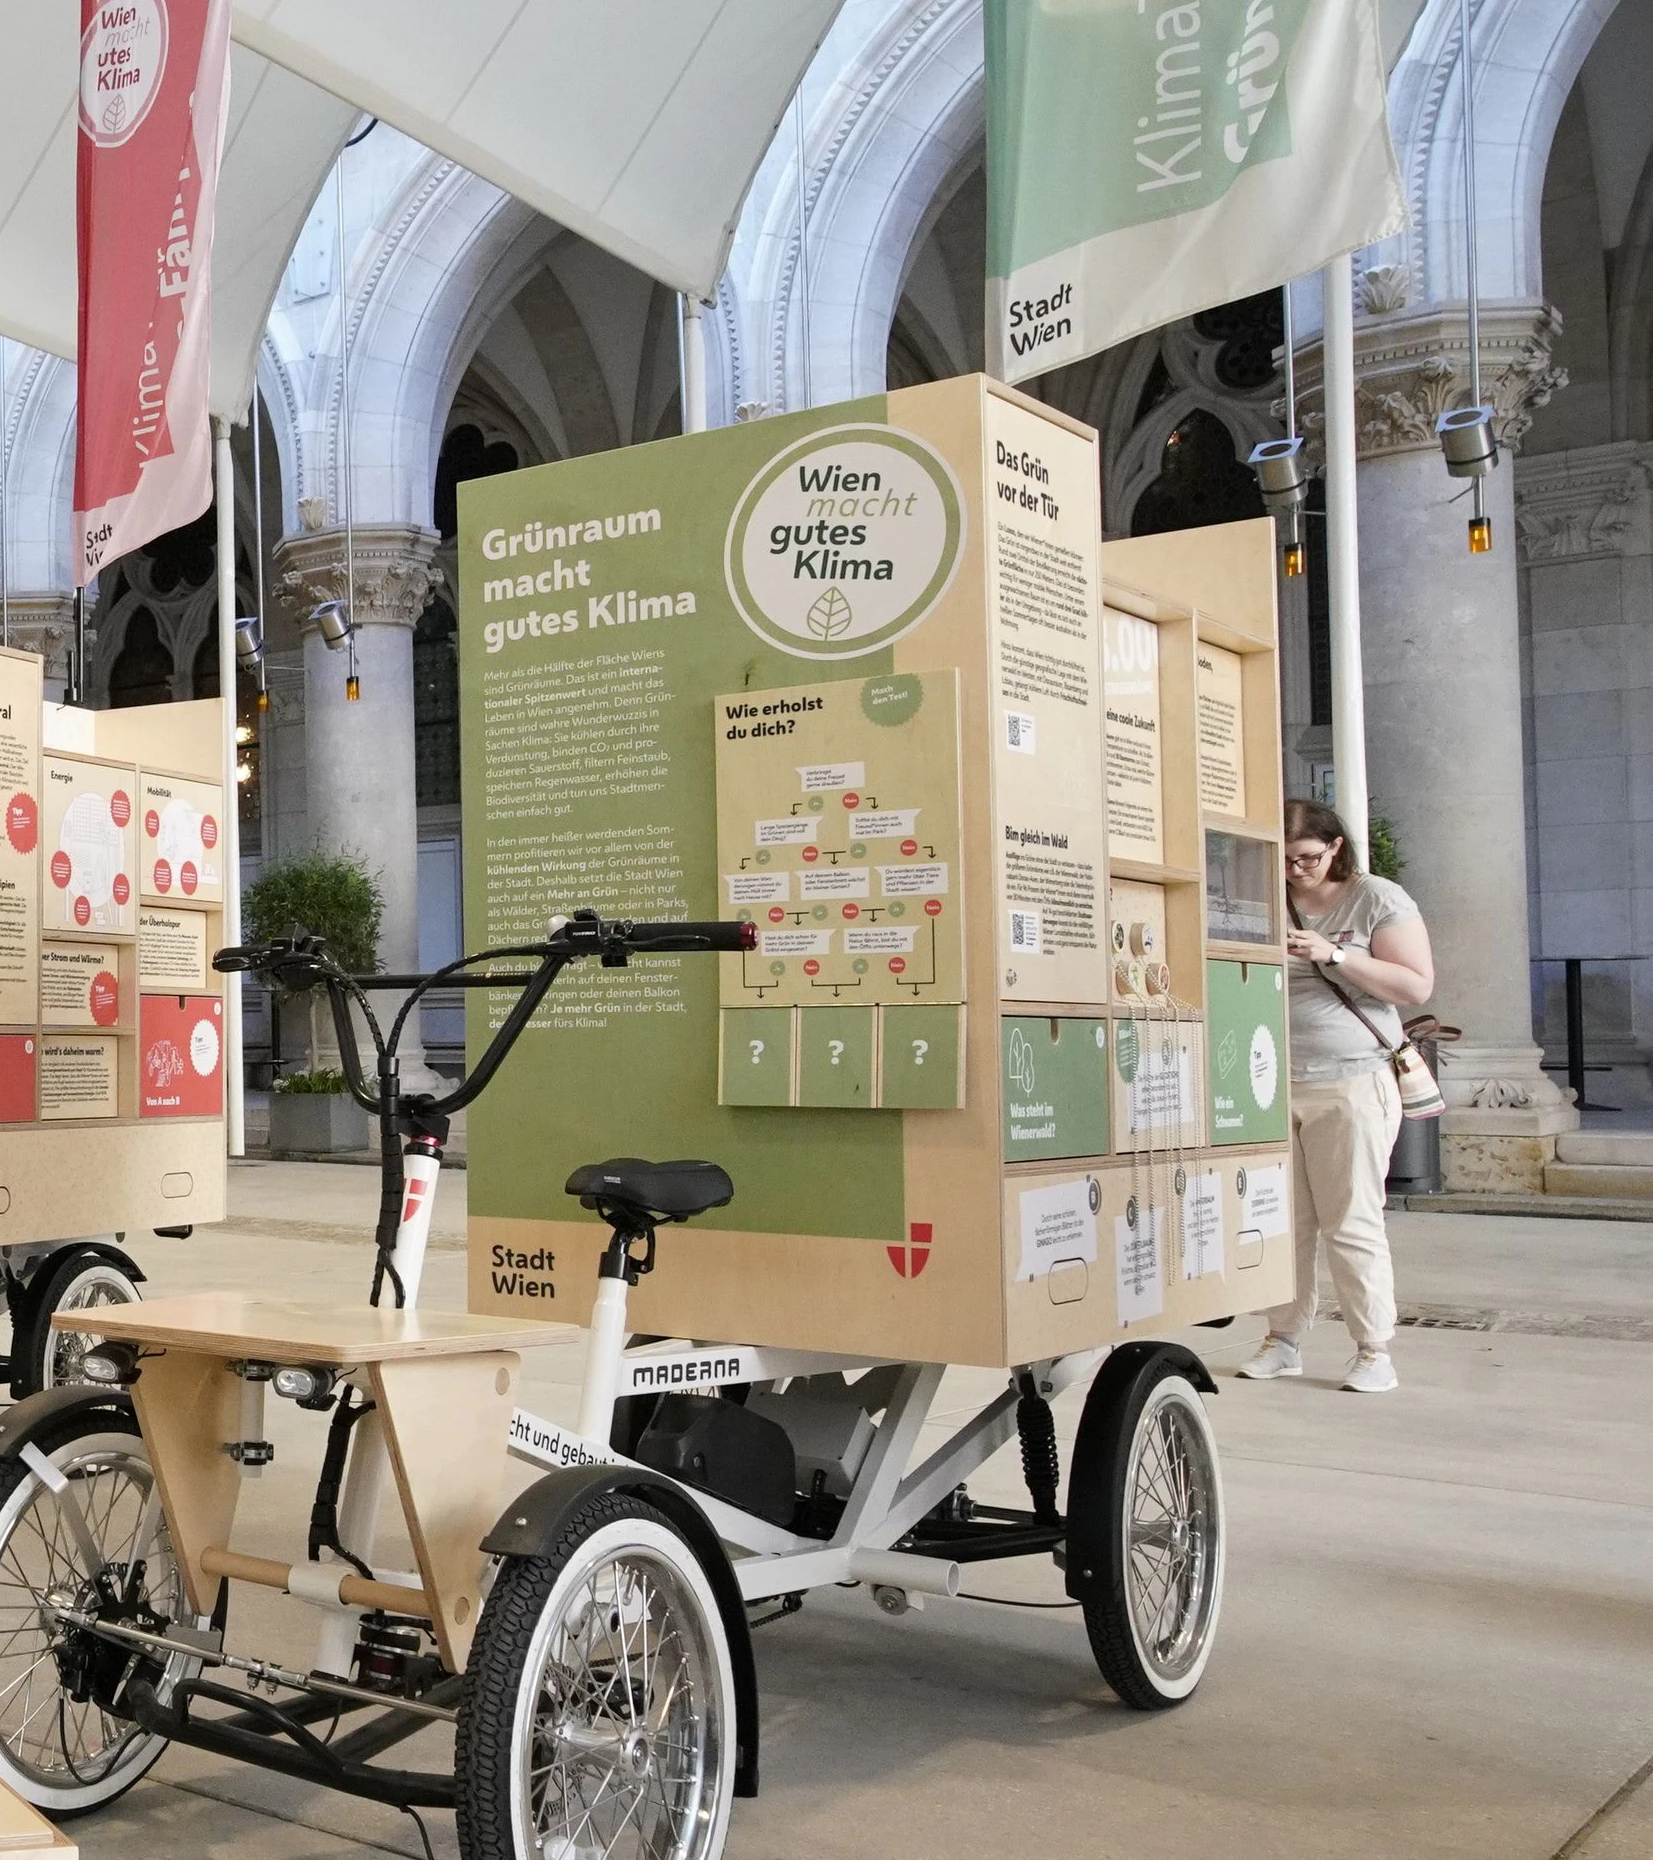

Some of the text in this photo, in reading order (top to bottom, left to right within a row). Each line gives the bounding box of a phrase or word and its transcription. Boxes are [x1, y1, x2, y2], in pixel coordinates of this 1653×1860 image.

[101, 7, 136, 29] Wien
[97, 47, 131, 67] utes
[97, 68, 140, 91] Klima
[1009, 283, 1073, 327] Stadt
[1009, 317, 1072, 356] Wien
[997, 440, 1049, 485] Das Grün
[799, 465, 881, 493] Wien
[806, 488, 918, 517] macht
[997, 481, 1059, 521] vor der Tür
[482, 508, 661, 560] Grünraum
[769, 520, 867, 554] gutes
[793, 549, 894, 580] Klima
[484, 559, 591, 603] macht
[484, 590, 696, 653] gutes Klima
[871, 685, 893, 696] Mach
[872, 691, 908, 705] den Test!
[726, 697, 823, 719] Wie erholst
[726, 720, 795, 740] du dich?
[51, 770, 73, 784] Energie
[147, 786, 172, 798] Mobilität
[1005, 826, 1069, 849] Bim gleich im Wald
[51, 952, 104, 964] Strom und Wärme?
[749, 1039, 765, 1065] ?
[828, 1039, 845, 1065] ?
[911, 1039, 929, 1065] ?
[1010, 1101, 1053, 1118] Was steht im
[1010, 1122, 1056, 1140] Wienerwald?
[492, 1244, 555, 1271] Stadt
[491, 1271, 555, 1298] Wien
[633, 1358, 740, 1387] MADERNA
[533, 1432, 560, 1455] und
